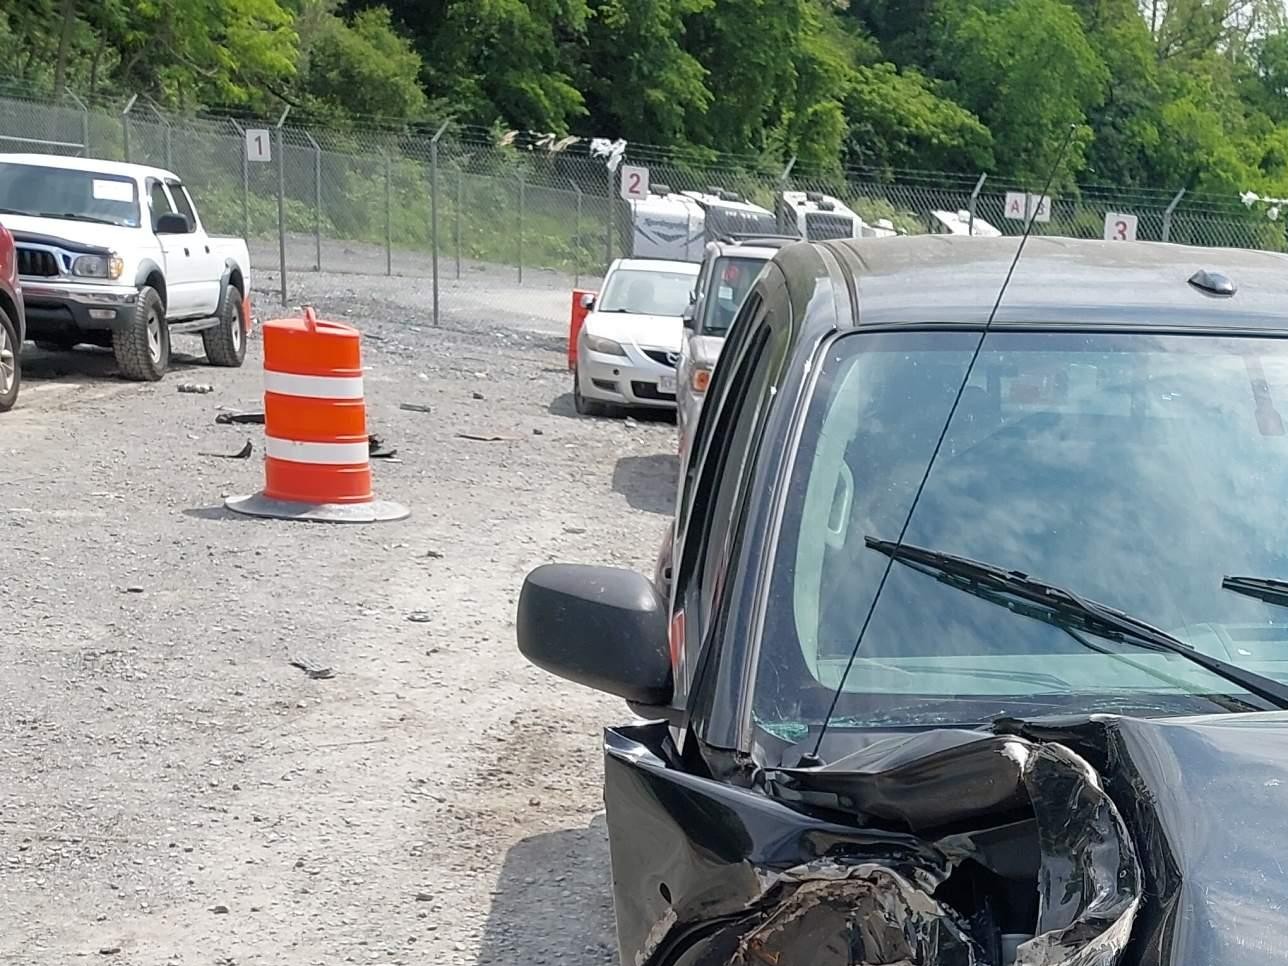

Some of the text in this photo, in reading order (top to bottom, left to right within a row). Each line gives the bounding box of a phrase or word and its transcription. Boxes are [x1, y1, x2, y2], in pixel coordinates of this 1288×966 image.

[254, 135, 262, 155] 1
[628, 172, 641, 195] 2
[1010, 200, 1019, 213] A
[1113, 220, 1128, 240] 3
